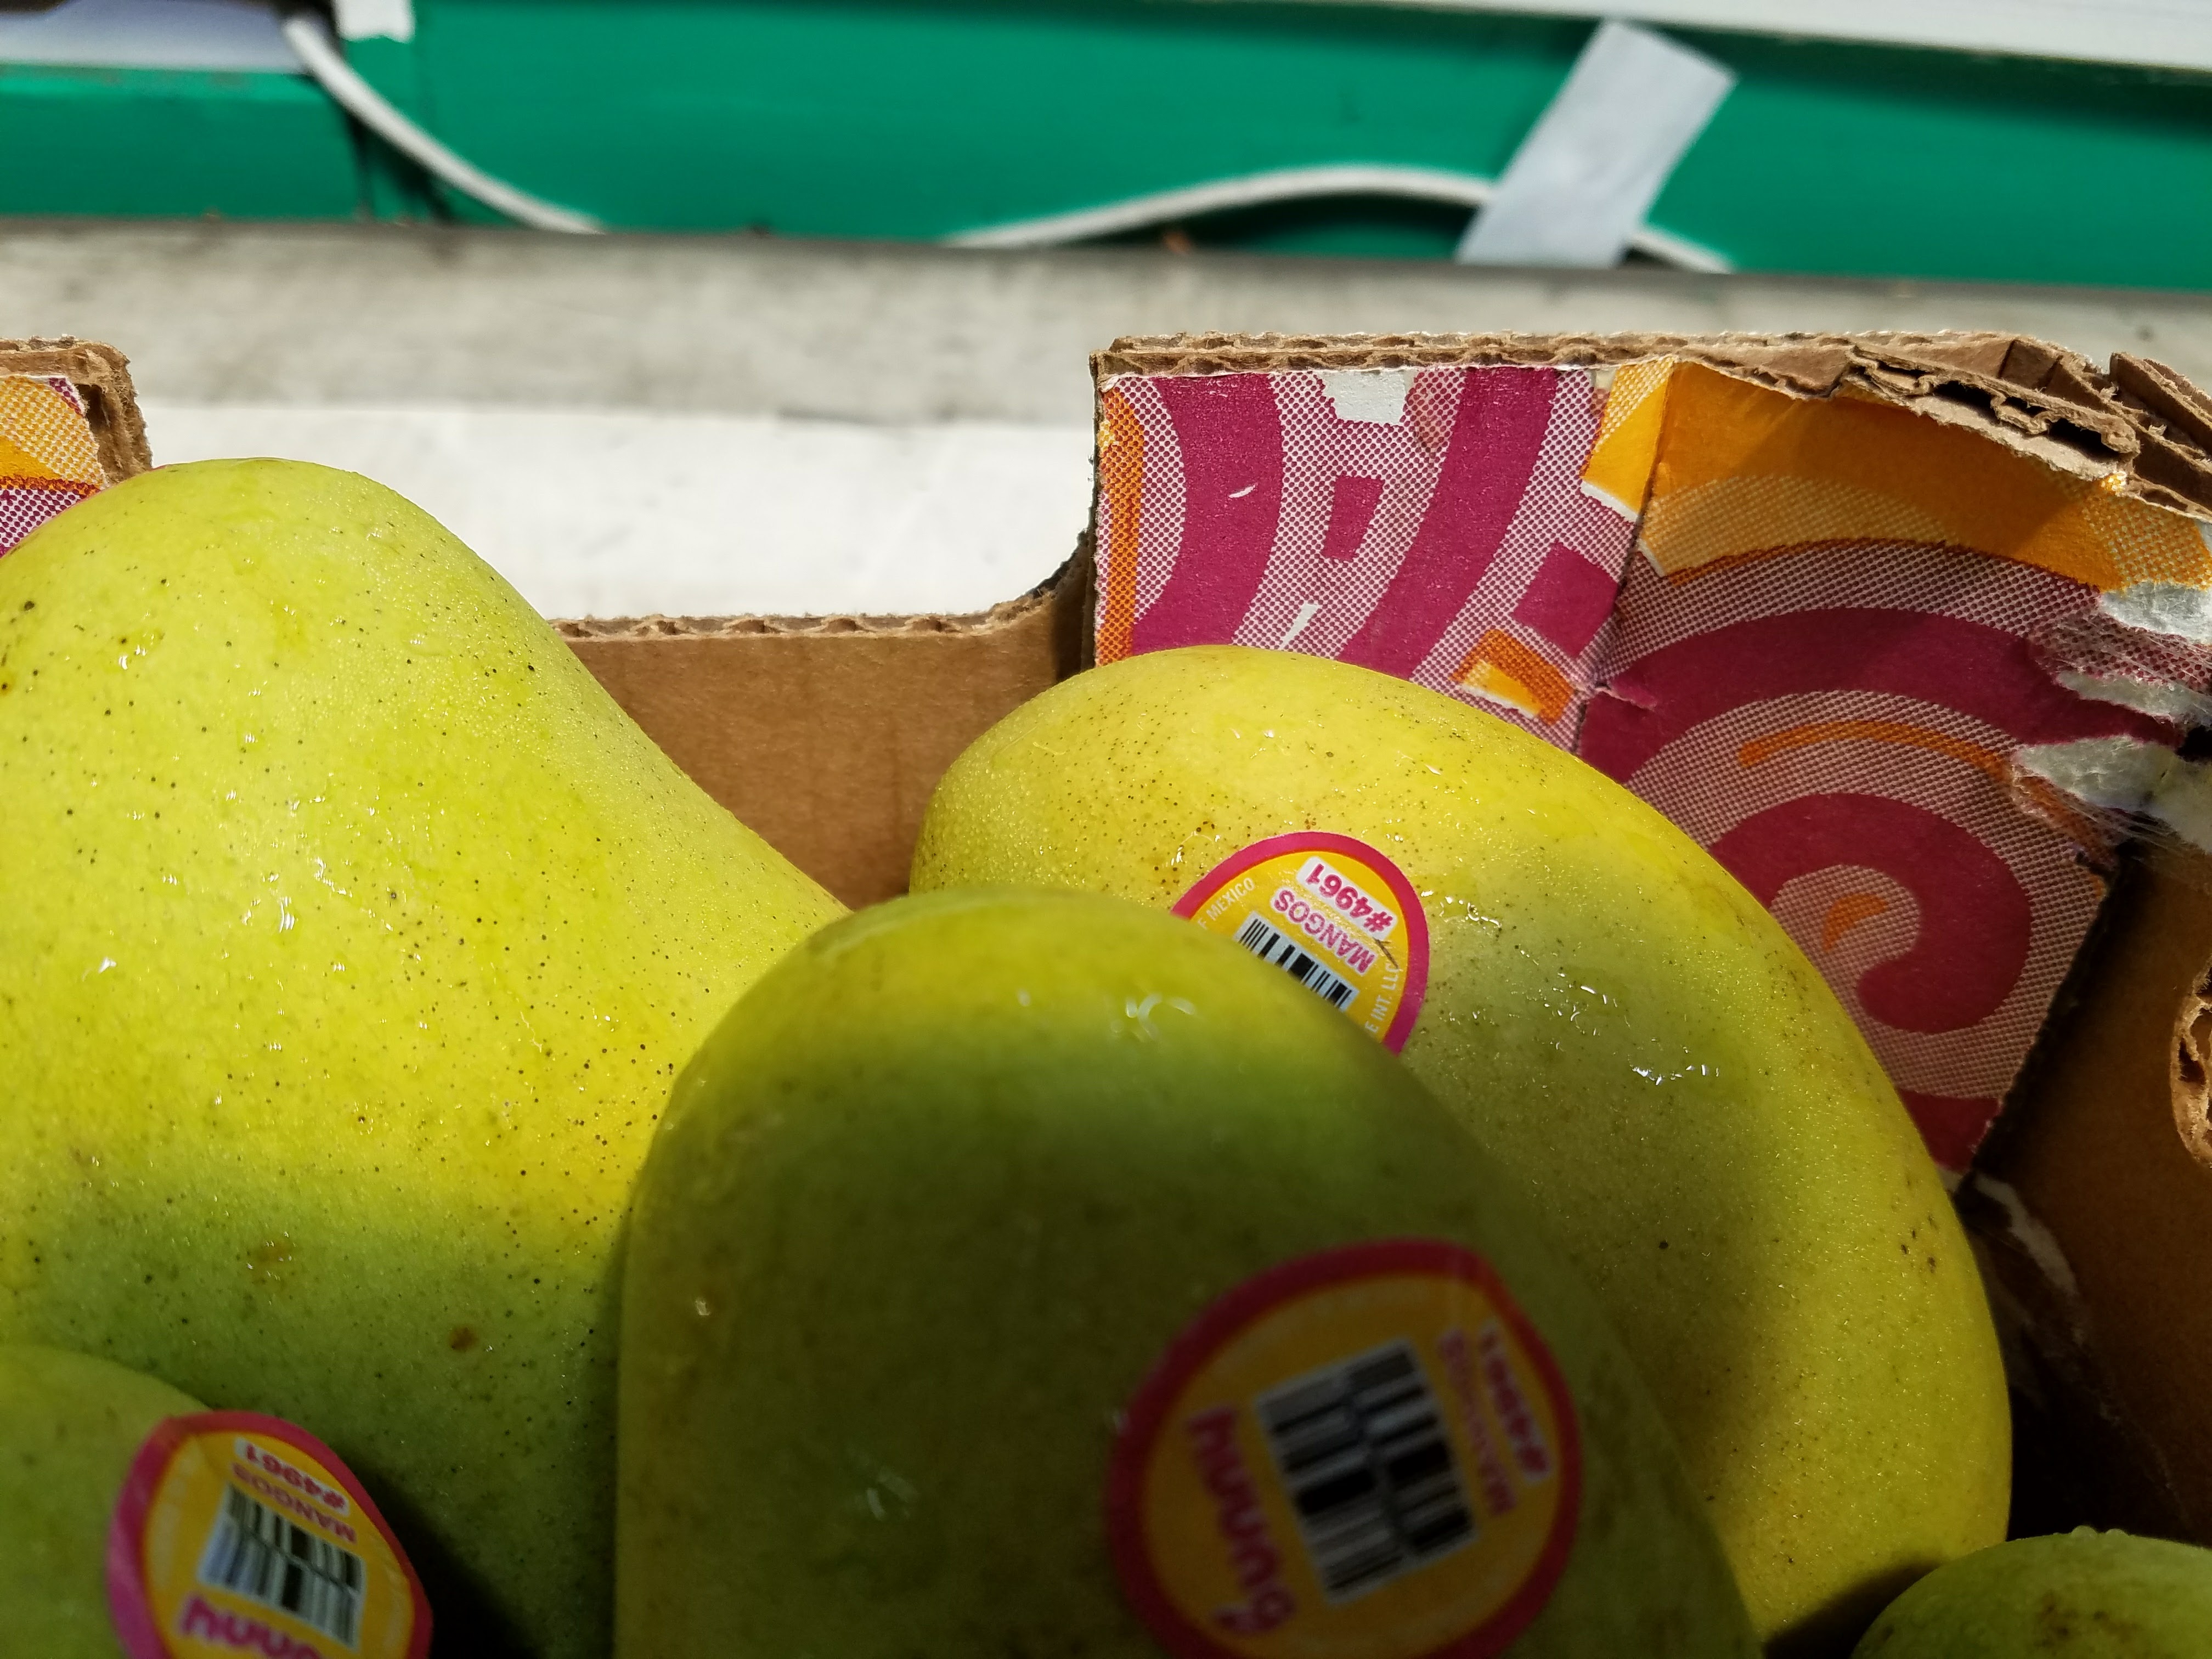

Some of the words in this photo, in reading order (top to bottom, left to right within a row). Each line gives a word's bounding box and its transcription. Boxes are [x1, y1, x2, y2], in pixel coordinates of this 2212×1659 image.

[1206, 878, 1255, 922] MEXICO
[1274, 889, 1376, 974] MANGOS
[1307, 864, 1393, 934] #4961
